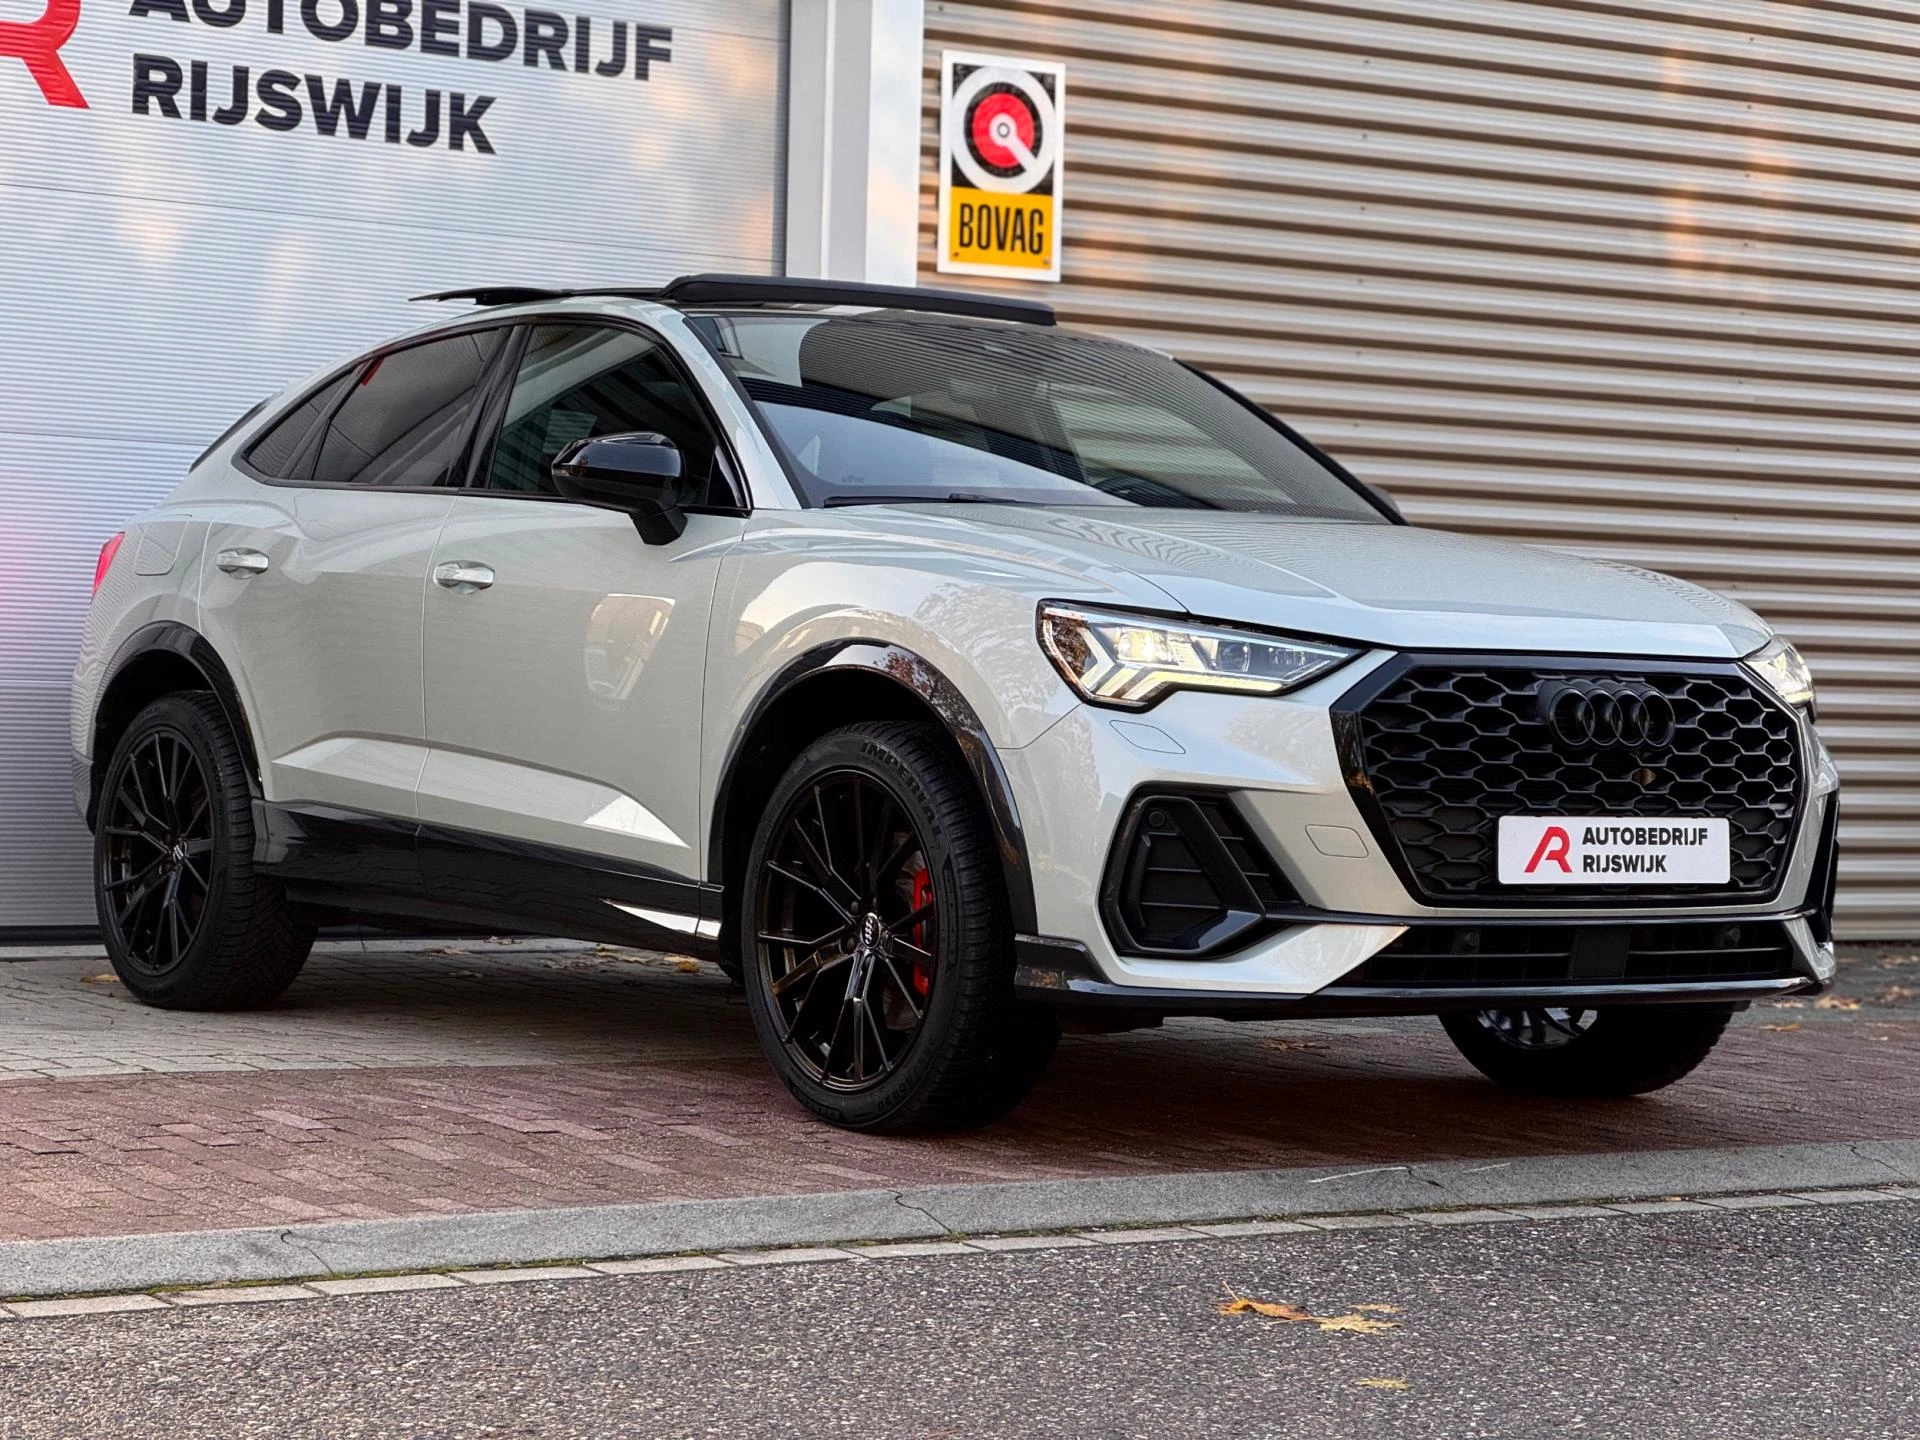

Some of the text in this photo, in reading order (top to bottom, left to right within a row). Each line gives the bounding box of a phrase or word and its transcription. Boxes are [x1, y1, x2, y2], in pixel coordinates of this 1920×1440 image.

[132, 53, 497, 155] RIJSWIJK
[959, 202, 1044, 255] BOVAG
[860, 740, 941, 842] IMPERIAL
[1582, 827, 1708, 846] AUTOBEDRIJF
[1583, 854, 1667, 873] RIJSWIJK
